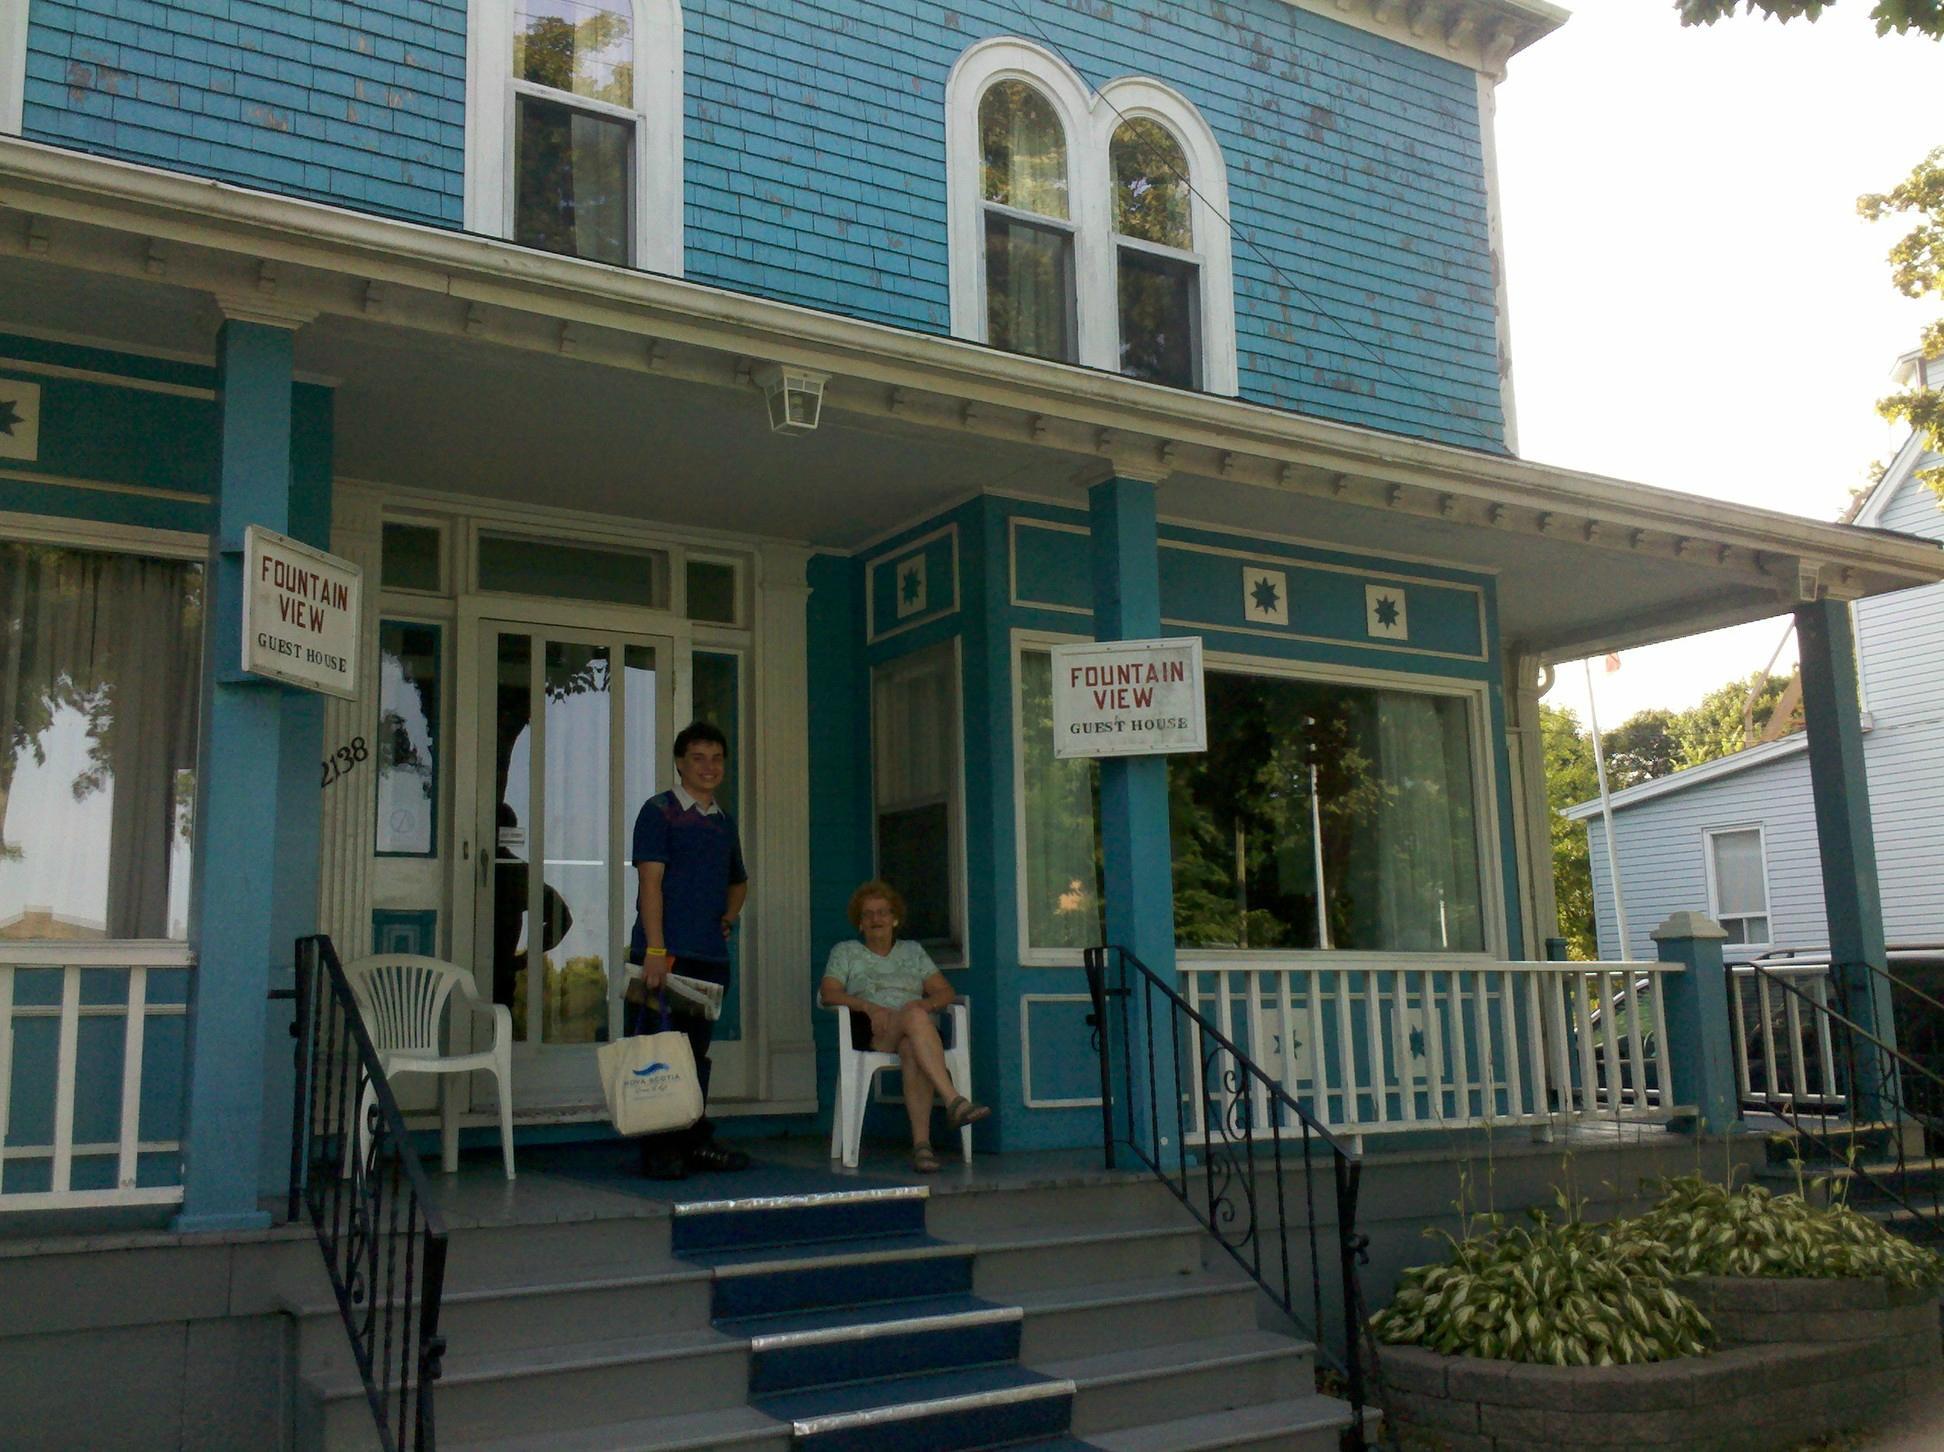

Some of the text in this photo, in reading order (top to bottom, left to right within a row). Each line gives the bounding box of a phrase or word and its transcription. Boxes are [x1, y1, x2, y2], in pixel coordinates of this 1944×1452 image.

[261, 555, 348, 611] FOUNTAIN
[279, 593, 325, 634] VIEW
[258, 632, 347, 673] GUEST HOUSE
[1070, 661, 1184, 688] FOUNTAIN
[1093, 687, 1154, 710] VIEW
[1070, 717, 1188, 734] GUEST HOUSE
[321, 736, 369, 788] 2138
